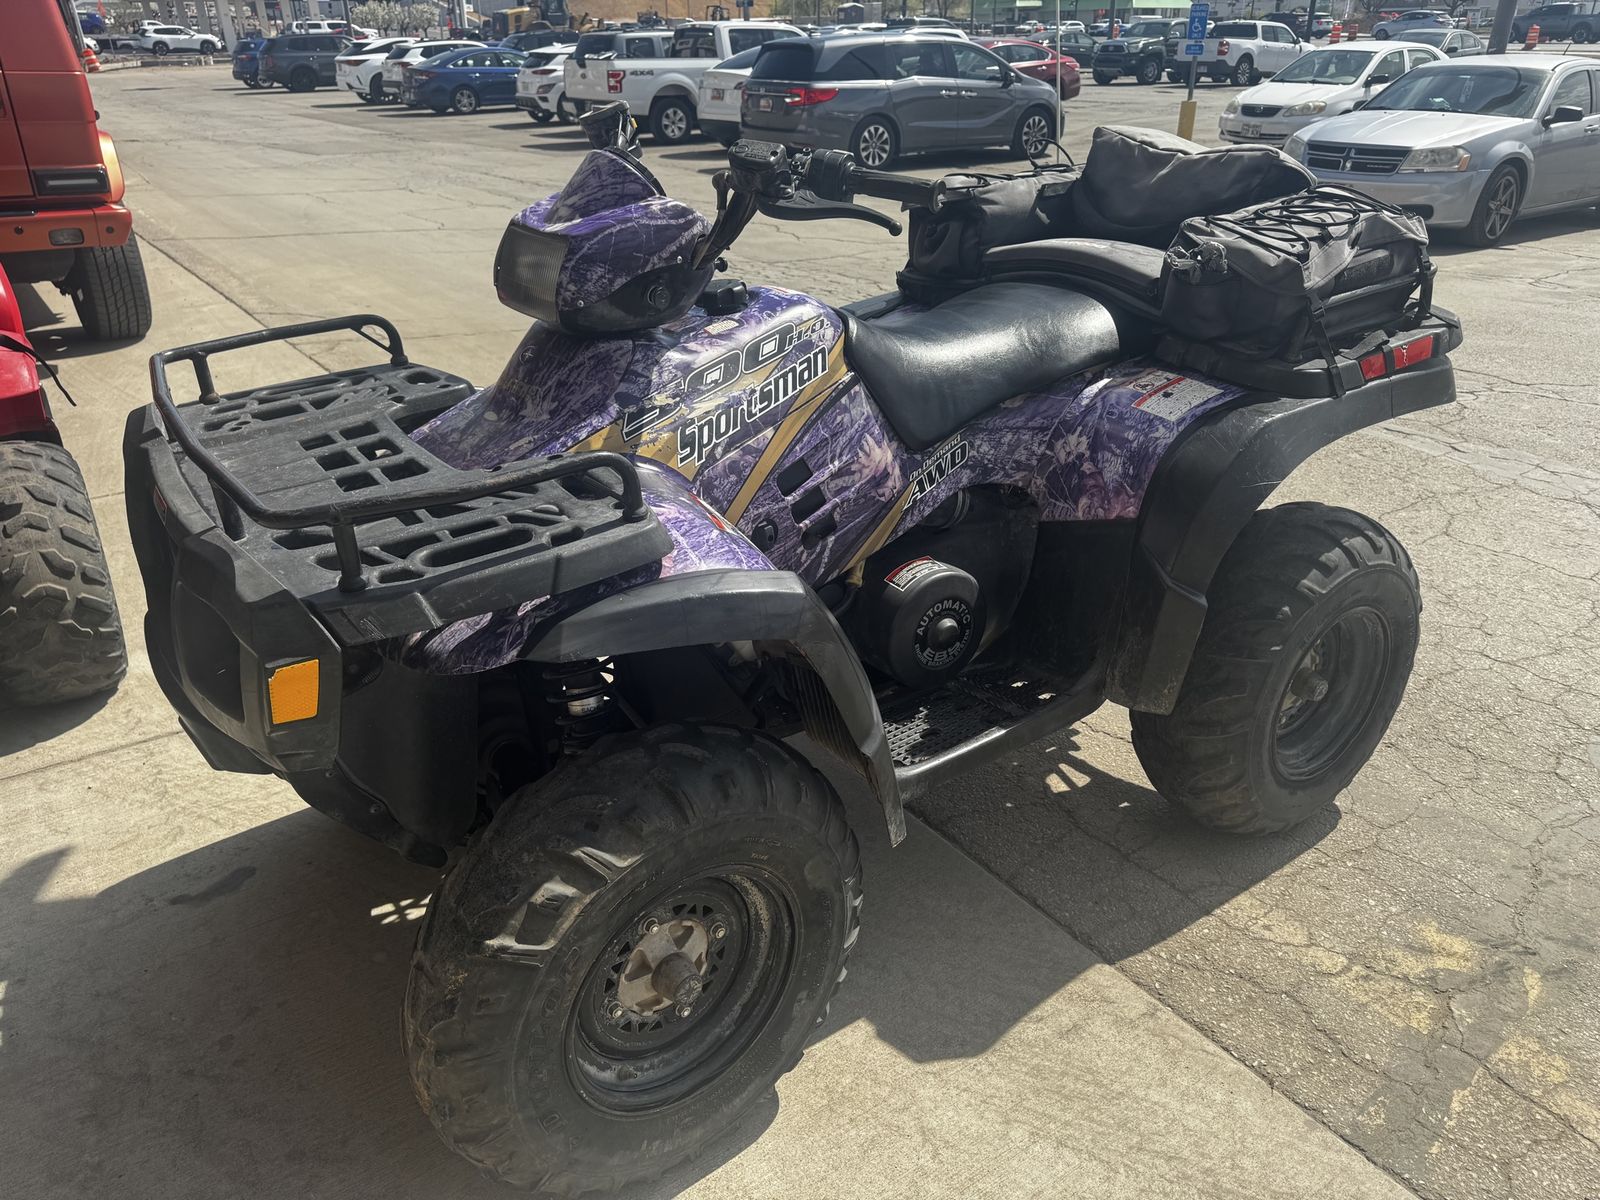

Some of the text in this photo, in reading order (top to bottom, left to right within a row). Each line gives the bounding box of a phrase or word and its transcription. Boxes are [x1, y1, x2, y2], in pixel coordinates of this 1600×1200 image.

[785, 316, 831, 350] H.O.
[676, 345, 829, 468] Sportsman
[902, 440, 969, 511] AWD
[909, 434, 961, 482] On Demand
[916, 599, 971, 636] AUTOMATIC
